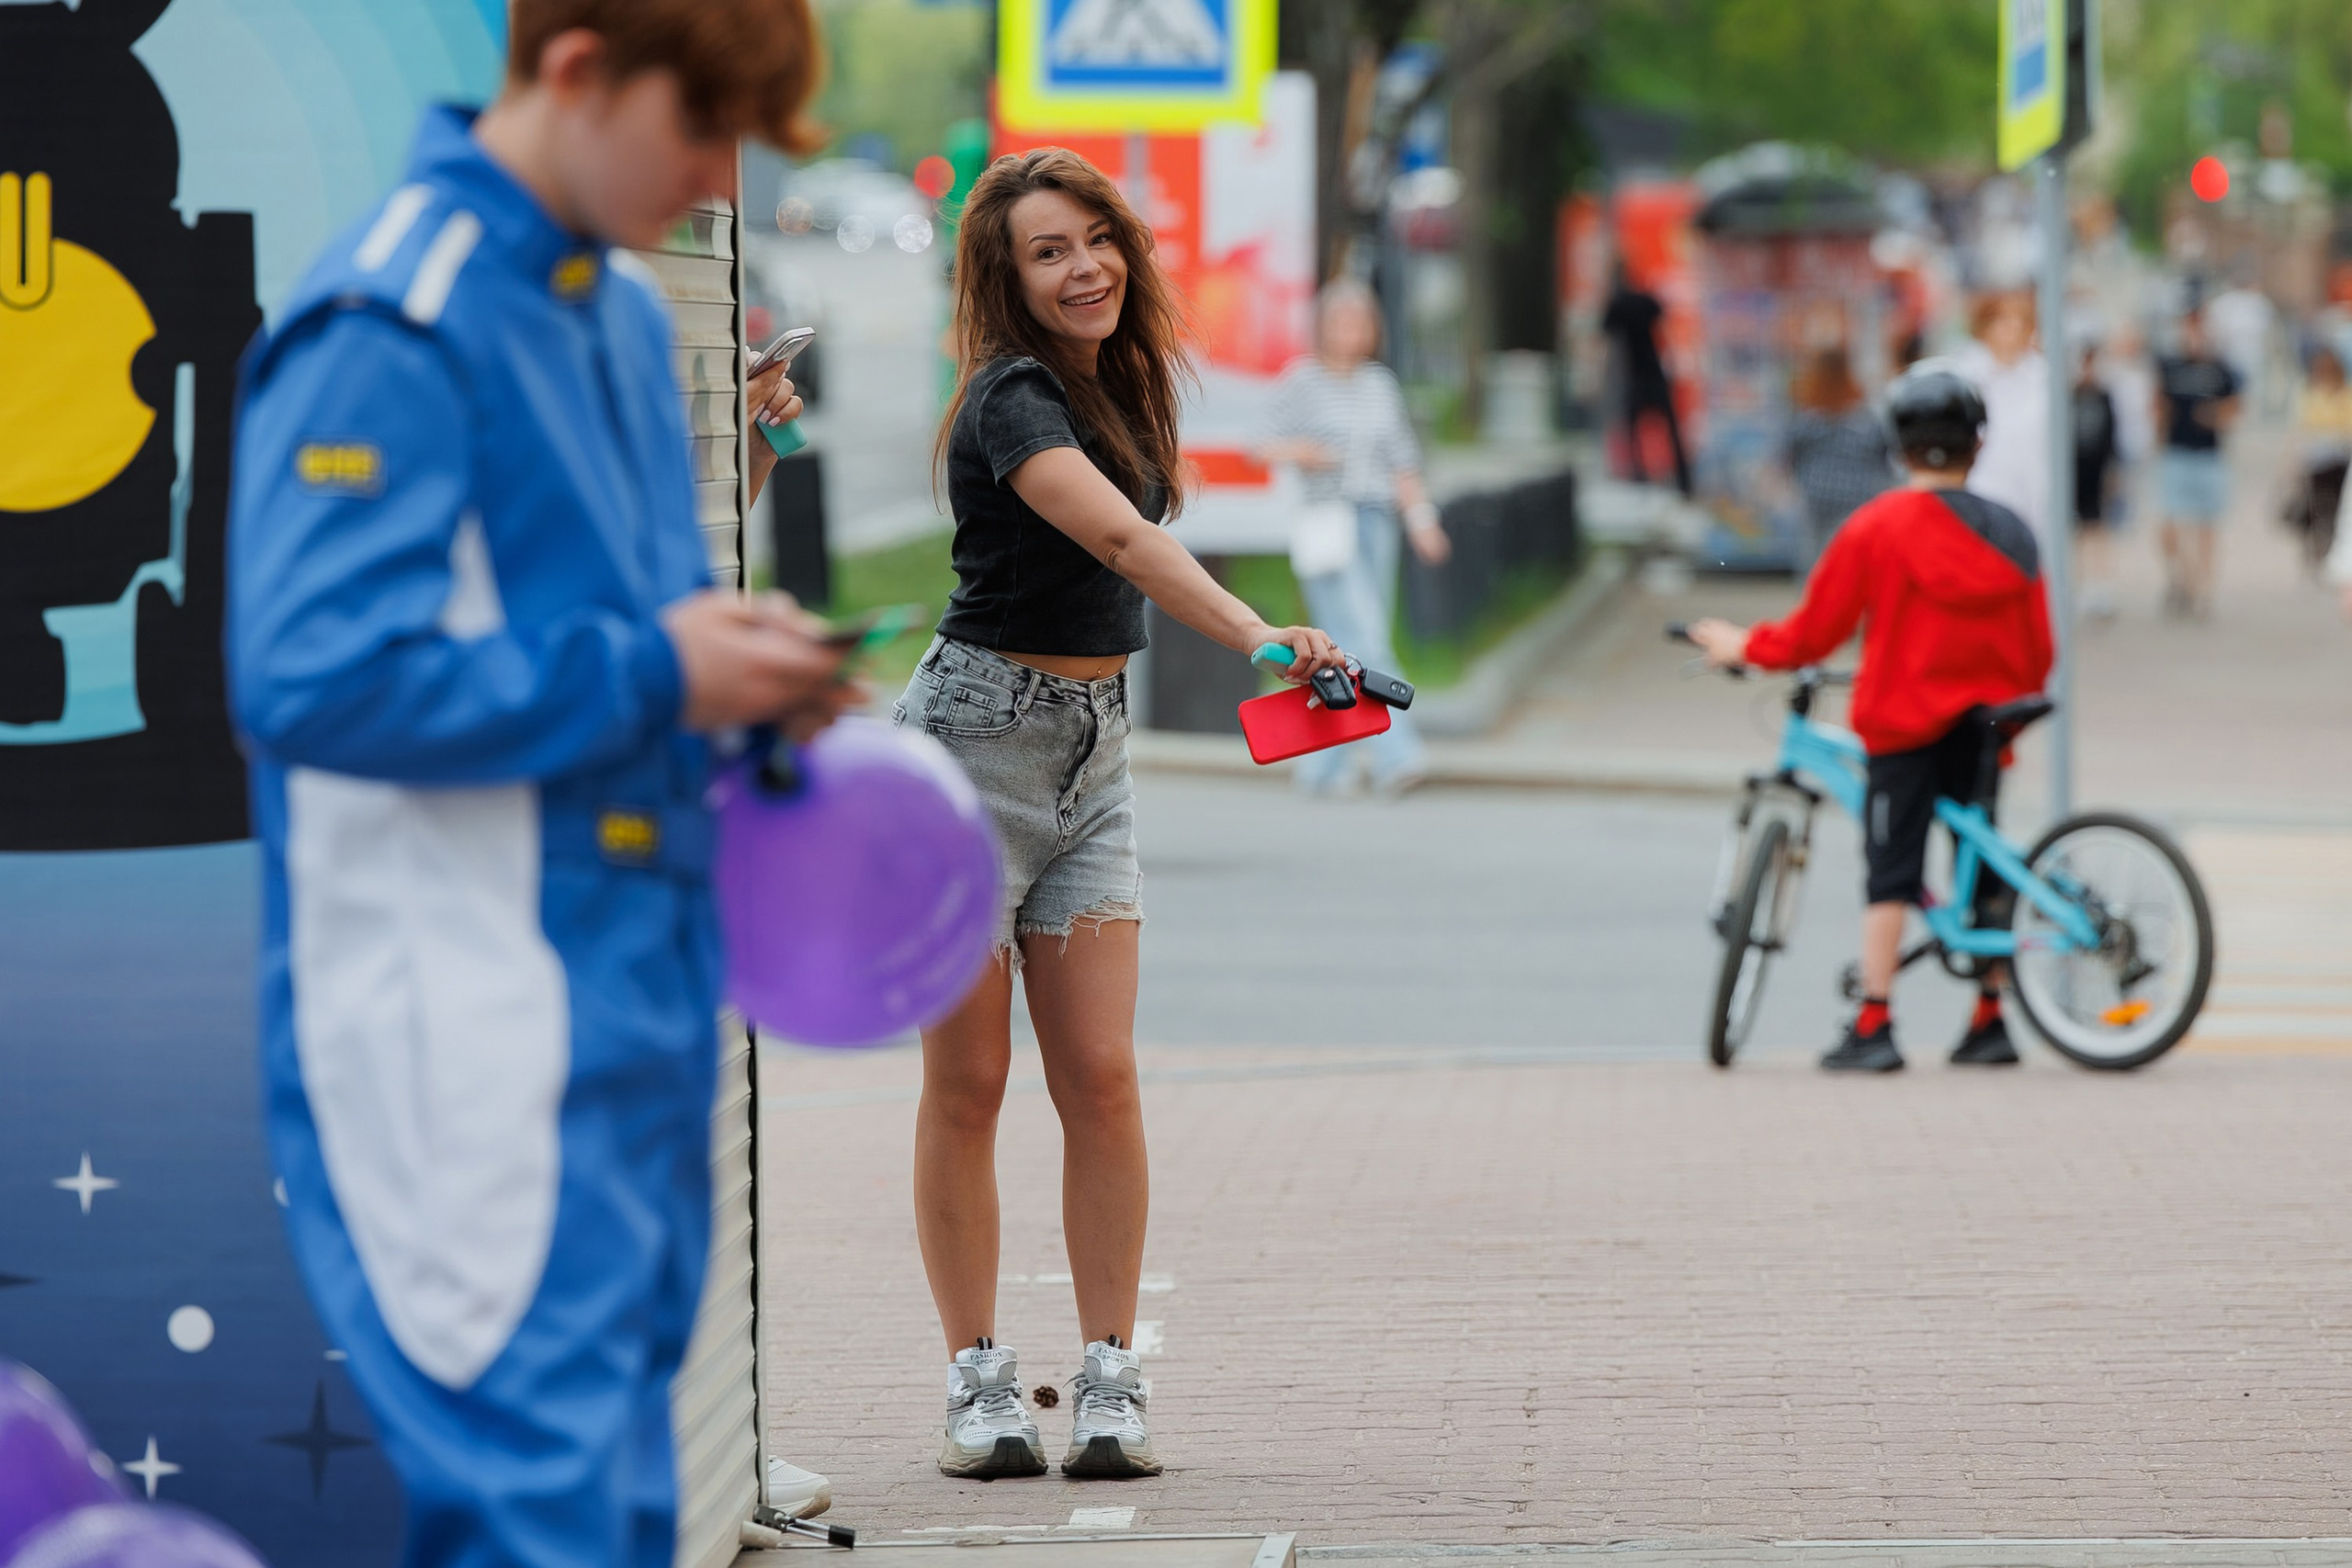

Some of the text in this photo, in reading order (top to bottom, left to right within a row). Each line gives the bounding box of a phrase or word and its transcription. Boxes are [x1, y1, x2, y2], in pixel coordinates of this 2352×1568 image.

[970, 1351, 1002, 1360] FASHION
[1098, 1347, 1129, 1360] FASHION
[1102, 1354, 1124, 1364] SPORT
